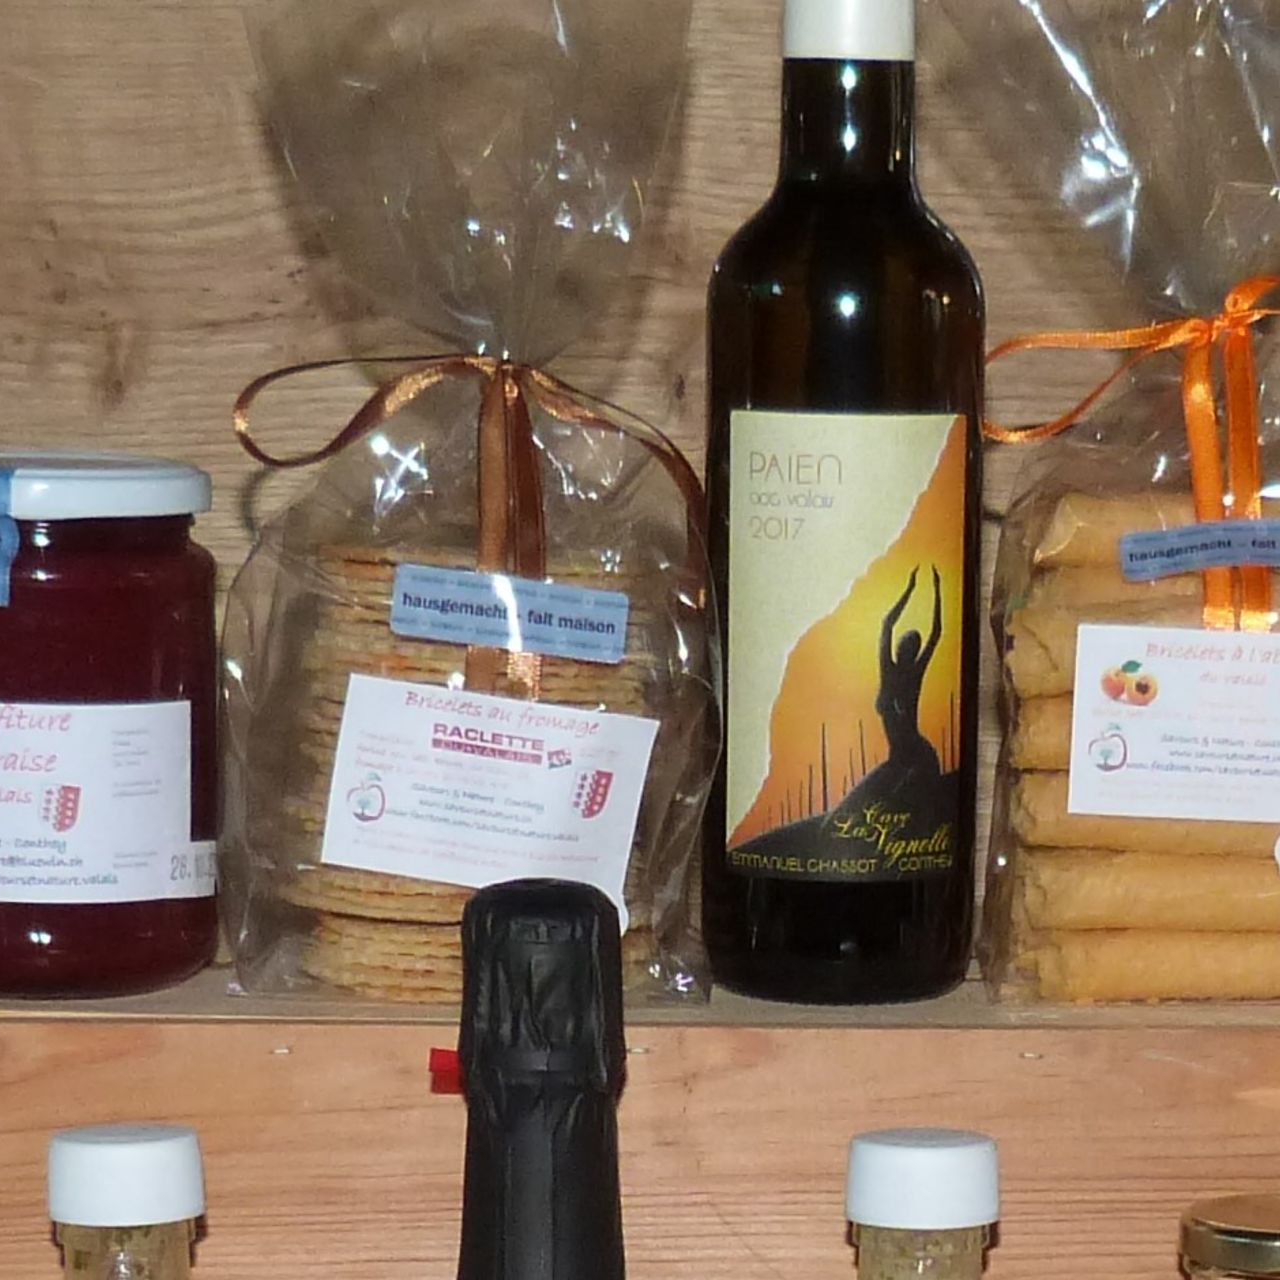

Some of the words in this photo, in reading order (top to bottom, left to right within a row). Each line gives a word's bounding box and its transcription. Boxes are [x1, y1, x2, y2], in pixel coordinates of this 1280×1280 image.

[750, 516, 805, 541] 2017
[1128, 537, 1232, 563] hausgemacht
[1251, 538, 1277, 551] fait
[402, 592, 508, 620] hausgemacht
[527, 608, 554, 627] fait
[558, 615, 615, 635] maison
[433, 723, 544, 751] RACLETTE
[807, 857, 878, 872] CHASSOT
